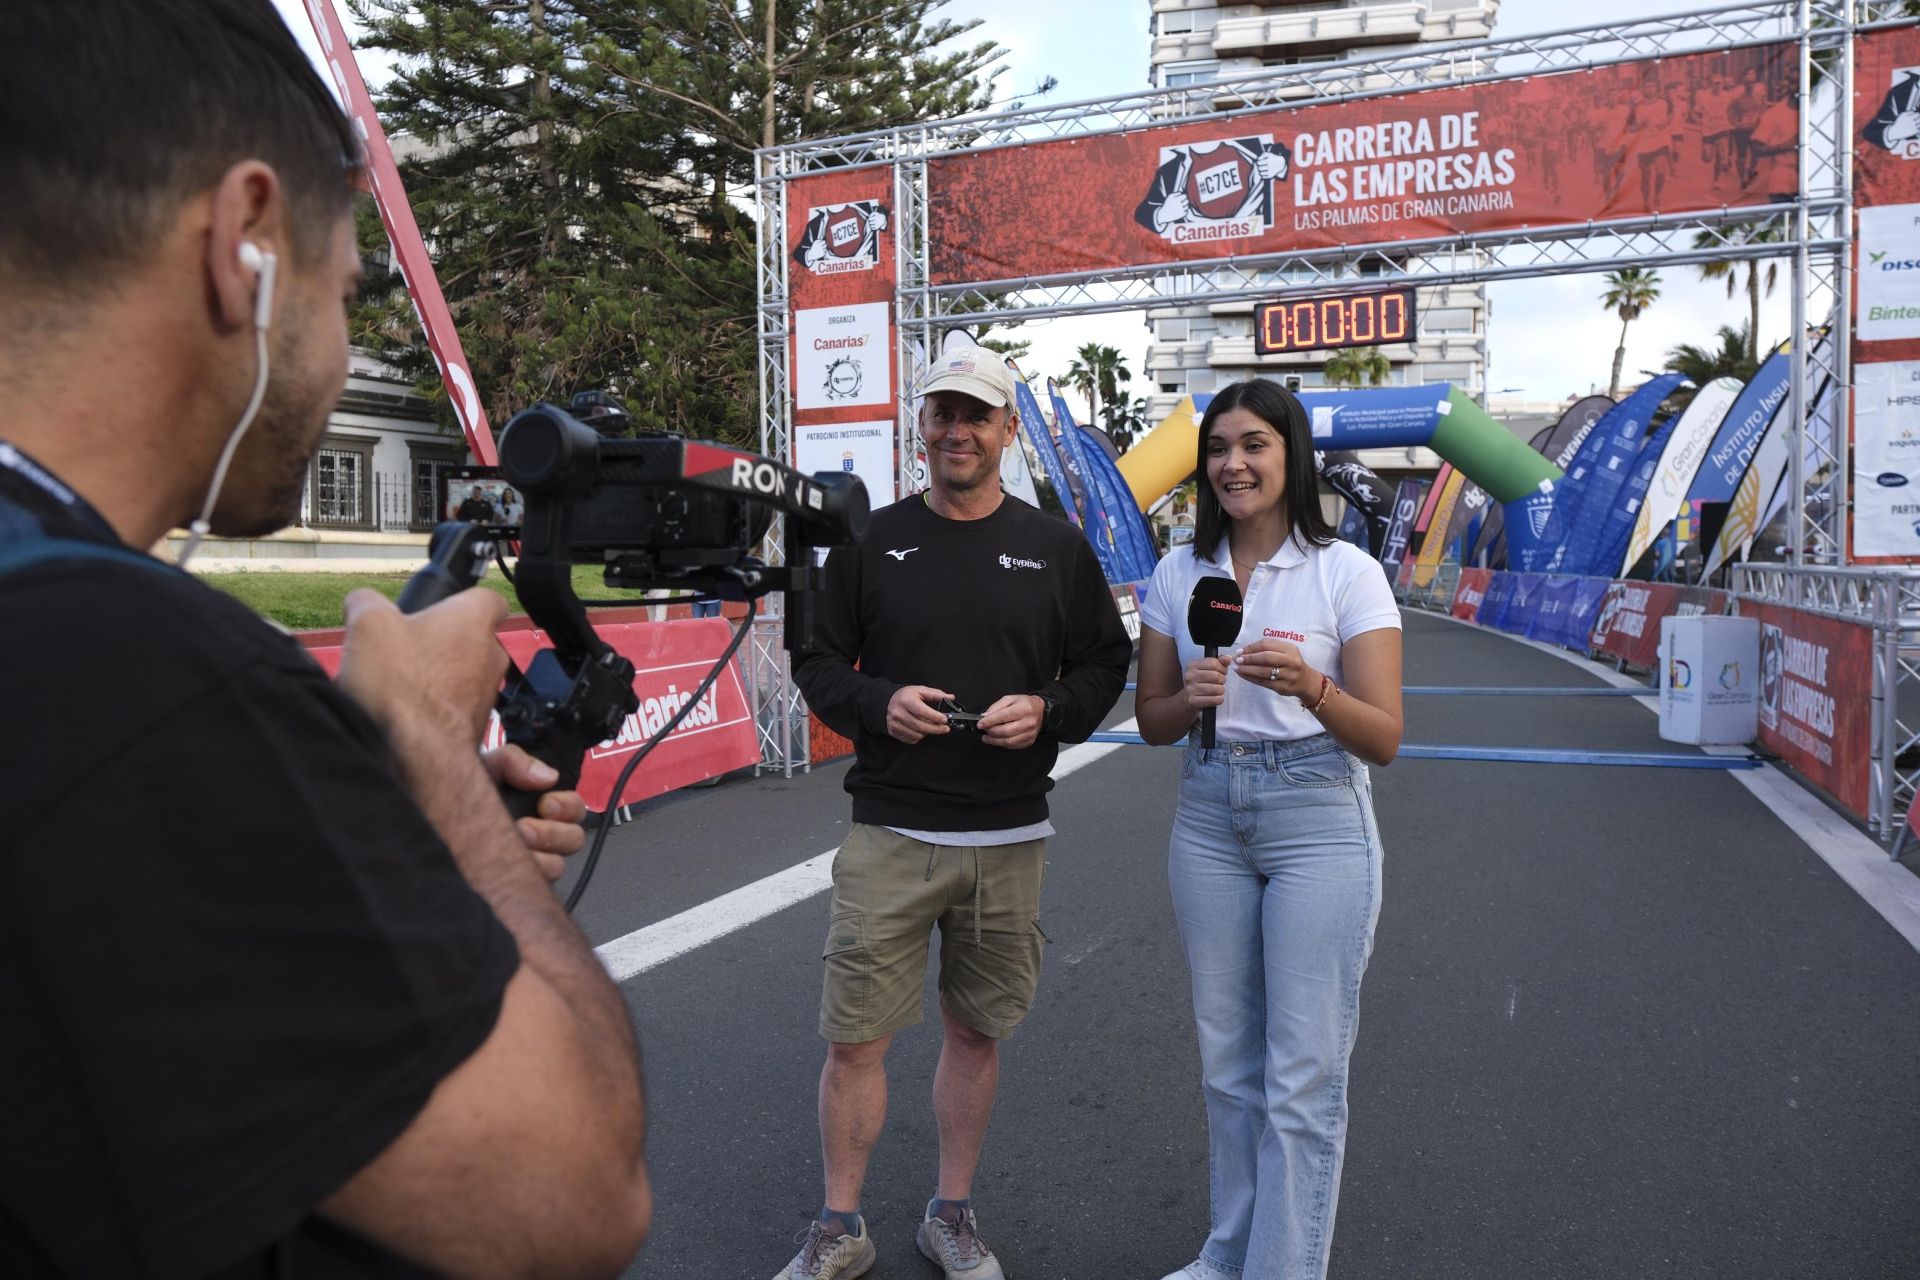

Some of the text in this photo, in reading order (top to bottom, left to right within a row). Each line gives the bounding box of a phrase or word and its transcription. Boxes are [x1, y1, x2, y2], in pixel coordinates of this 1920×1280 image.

[1294, 111, 1480, 168] CARRERA DE
[1199, 167, 1240, 195] #C7CE
[1294, 148, 1516, 207] LAS EMPRESAS
[1294, 190, 1514, 230] LAS PALMAS DE GRAN CANARIA
[833, 221, 858, 241] #C7CE
[1174, 217, 1260, 242] Canarias7
[828, 314, 856, 325] ORGANIZA
[1264, 294, 1405, 350] 0:00:00
[814, 333, 871, 351] Canarias7
[806, 428, 883, 441] PATROCINIO INSTITUCIONAL
